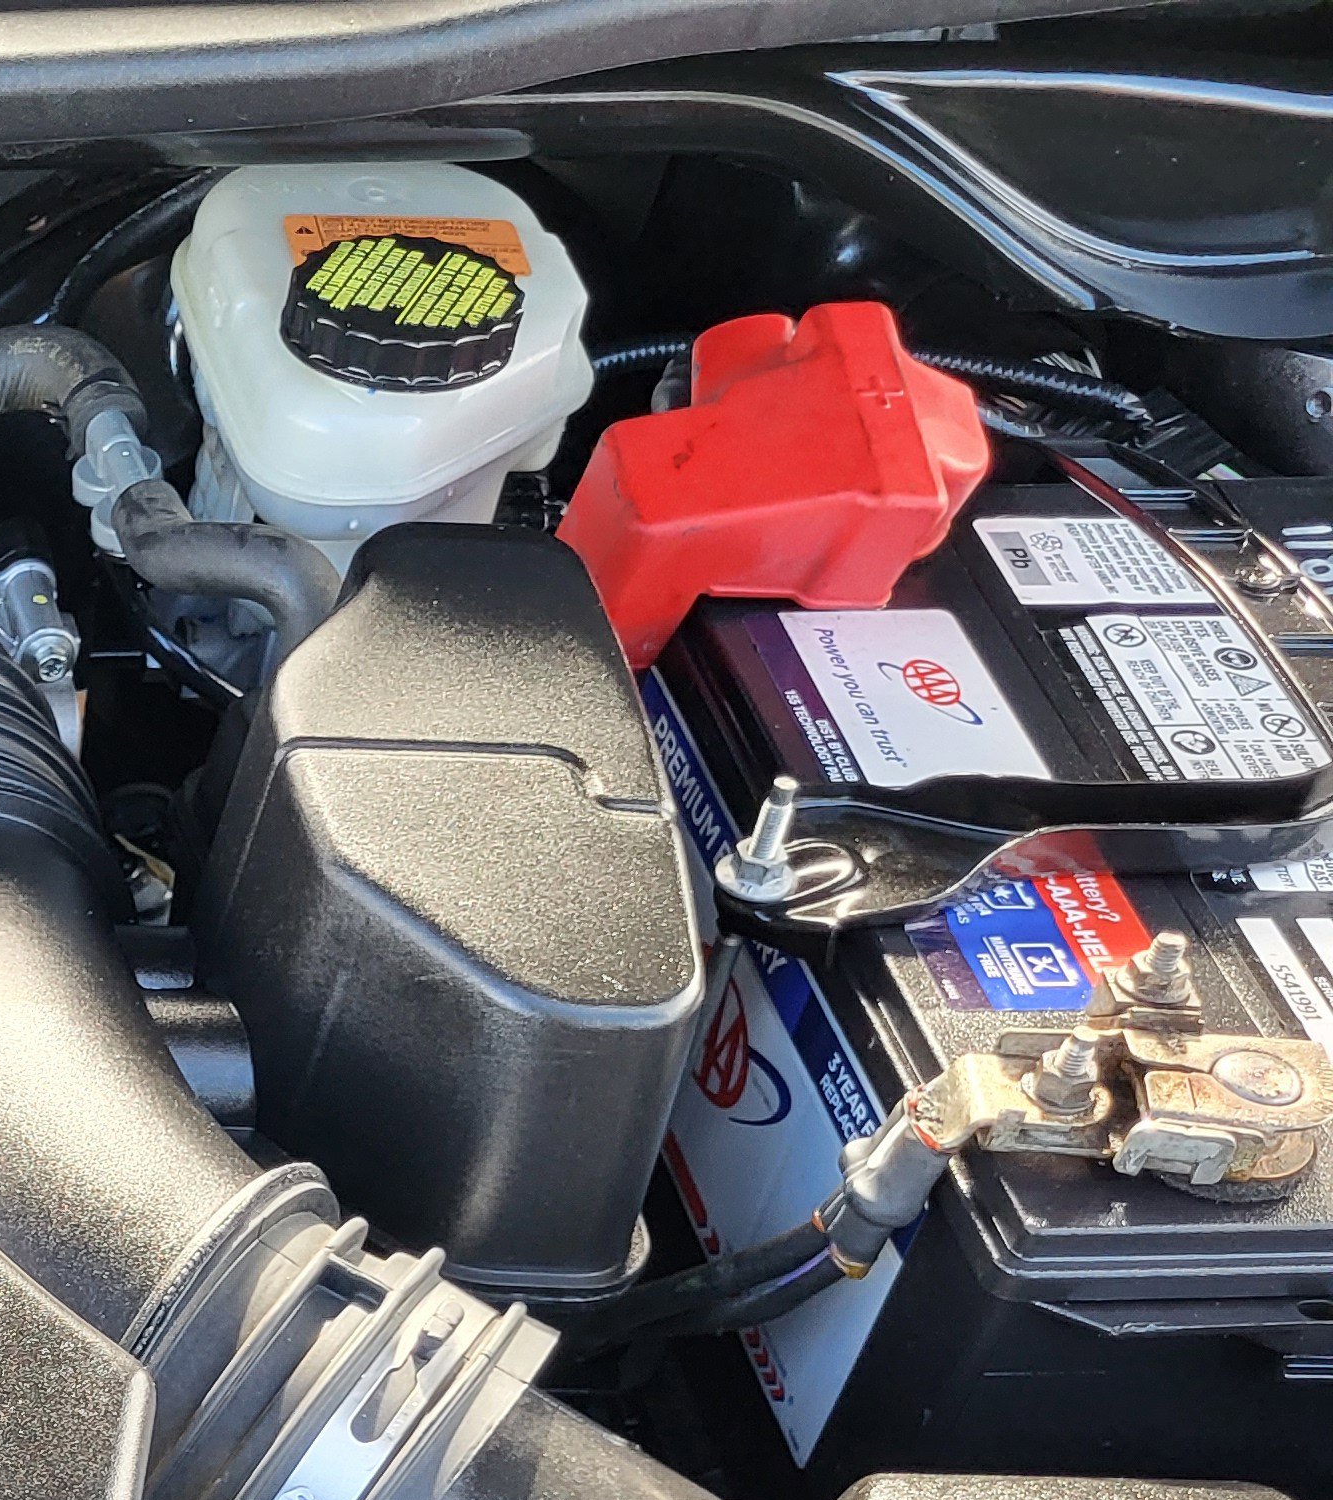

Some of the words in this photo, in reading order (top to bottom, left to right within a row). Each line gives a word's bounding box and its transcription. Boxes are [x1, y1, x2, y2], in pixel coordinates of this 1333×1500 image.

[1004, 548, 1032, 569] Pb
[1203, 620, 1235, 643] SHIELD
[1169, 620, 1207, 657] EXPLOSIVE
[1194, 658, 1223, 681] GASES
[813, 627, 849, 669] Power
[833, 667, 864, 700] you
[856, 700, 880, 726] can
[1123, 660, 1149, 680] REACH
[1136, 658, 1160, 675] KEEP
[904, 660, 960, 706] AAA
[1254, 702, 1275, 712] NO
[789, 704, 835, 765] TECHNOLOGY
[825, 741, 846, 755] BY
[1270, 743, 1298, 761] ACID
[832, 755, 861, 782] CLUB
[1200, 759, 1225, 776] READ
[654, 713, 722, 851] PREMIUM
[1308, 863, 1329, 888] FAST.
[1073, 871, 1121, 923] ttery?
[976, 953, 1001, 979] FREE
[989, 936, 1034, 996] MAINTENANCE
[1271, 964, 1322, 1021] 5541991
[828, 1052, 840, 1071] 3
[833, 1065, 867, 1123] YEAR
